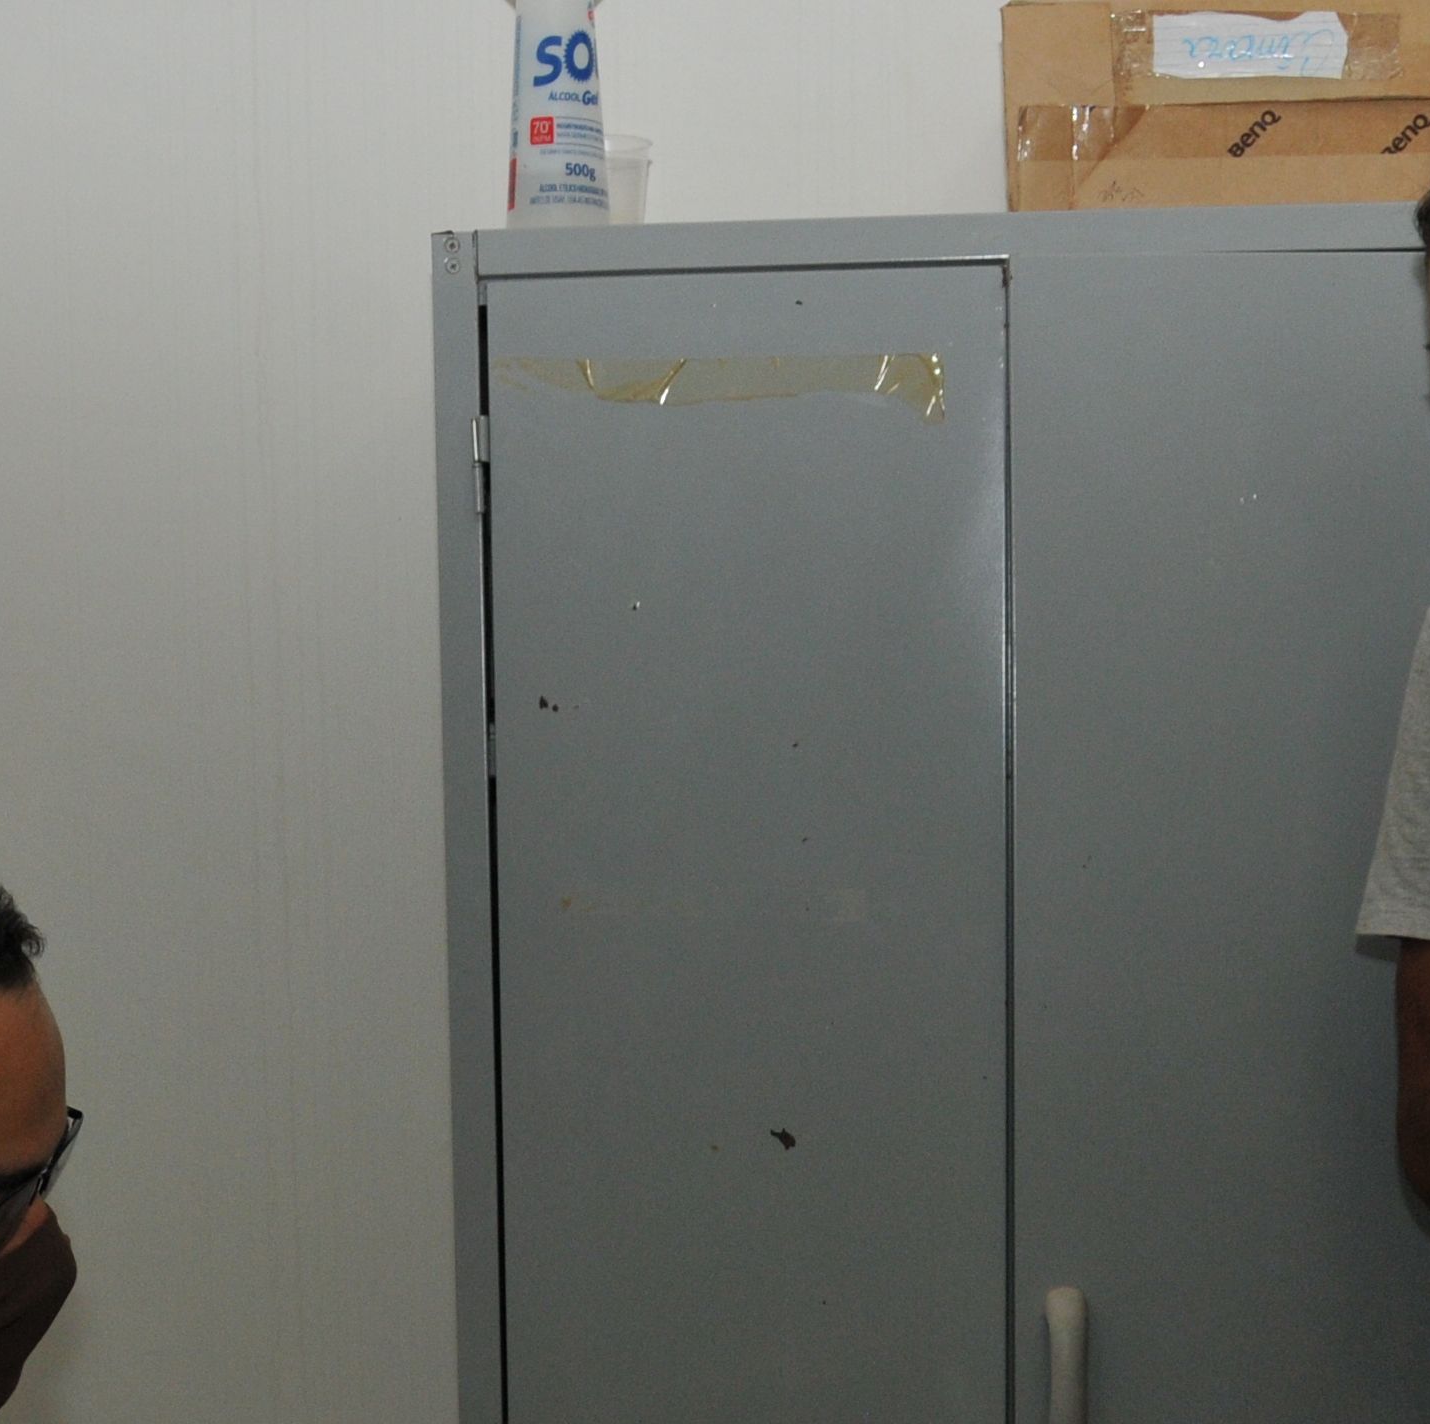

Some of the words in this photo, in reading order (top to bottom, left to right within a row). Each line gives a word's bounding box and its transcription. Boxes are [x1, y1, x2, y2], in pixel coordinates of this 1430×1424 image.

[533, 32, 599, 87] SO
[1227, 109, 1282, 158] BenQ
[565, 163, 596, 181] 500g
